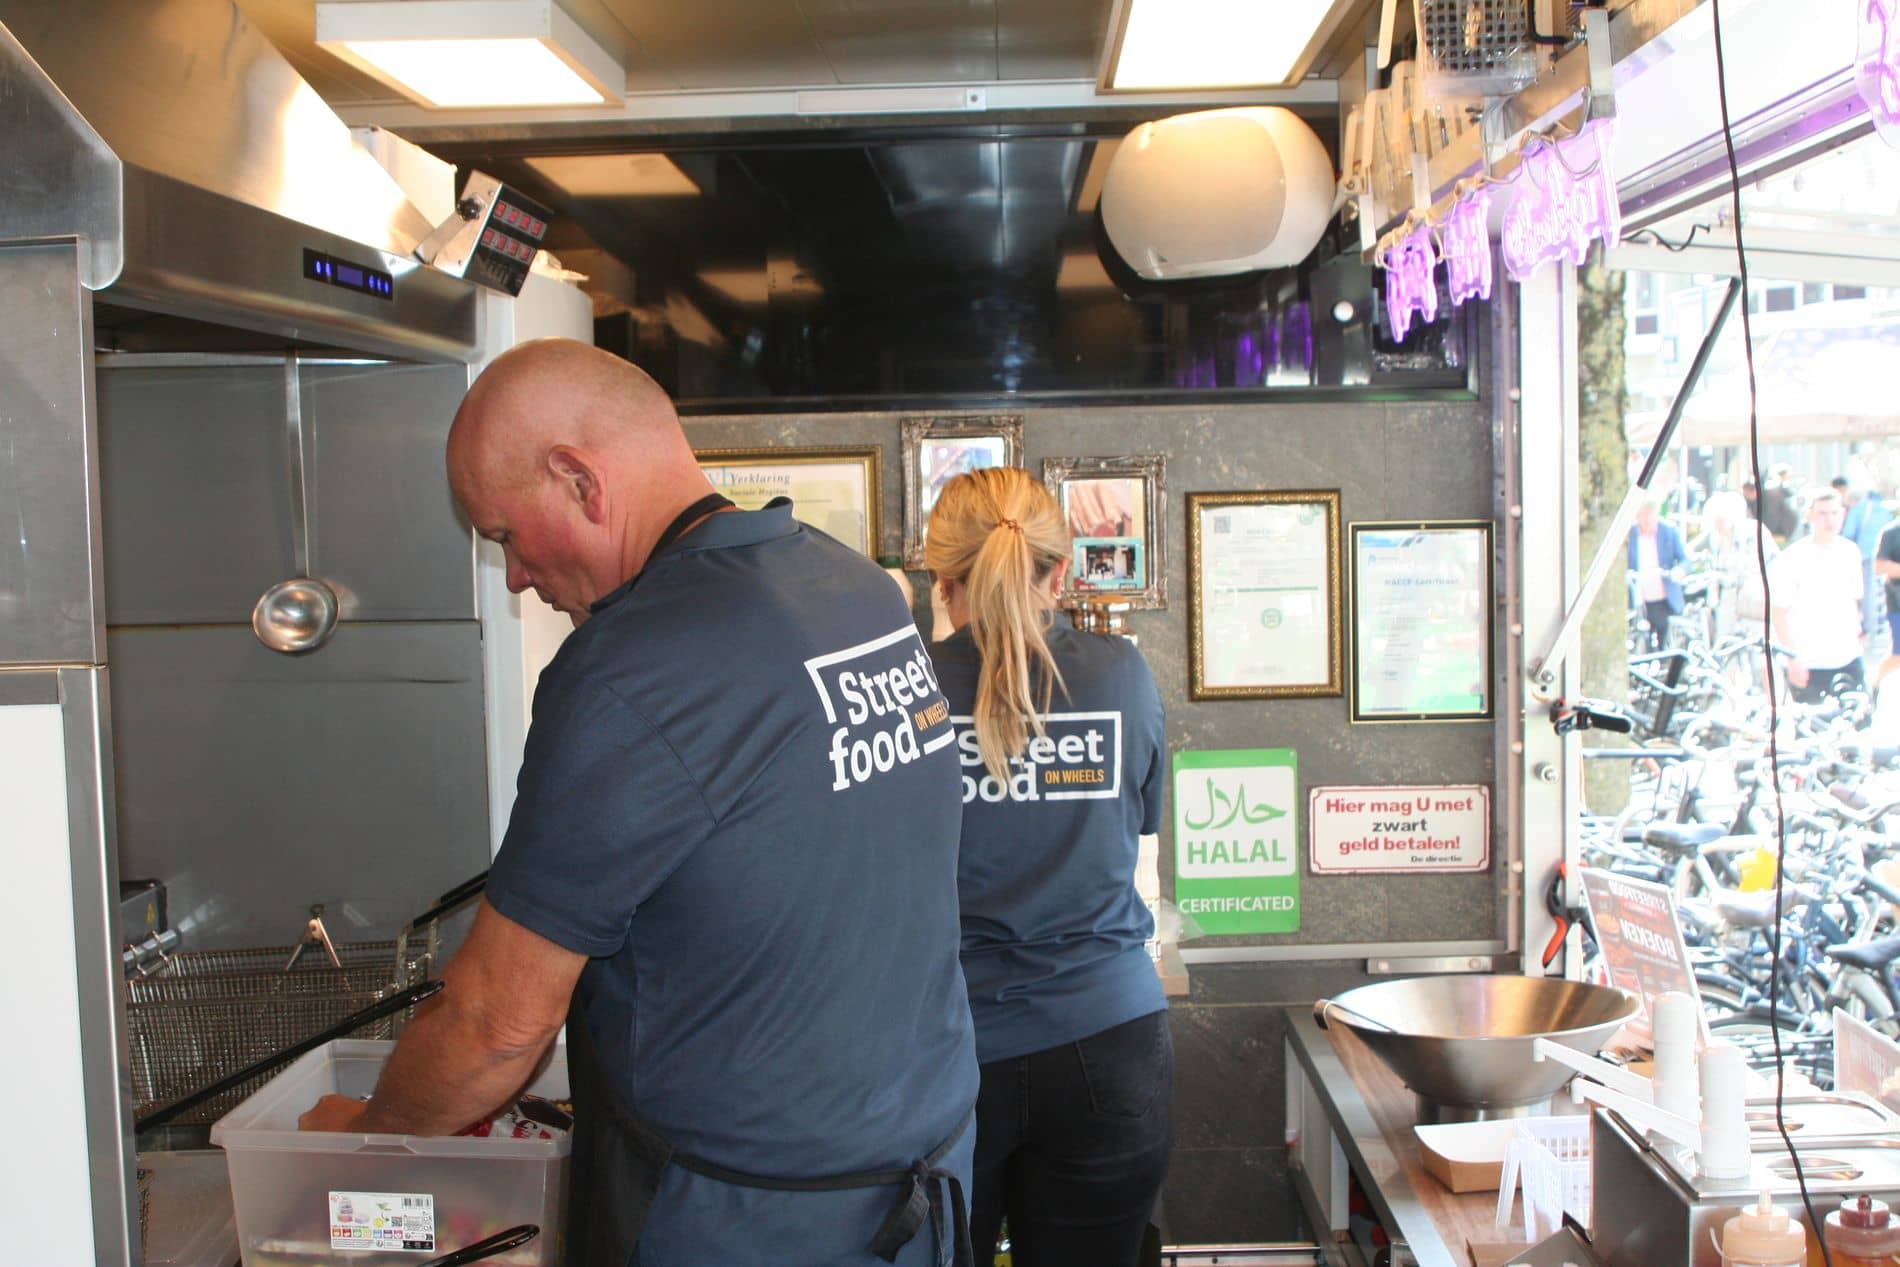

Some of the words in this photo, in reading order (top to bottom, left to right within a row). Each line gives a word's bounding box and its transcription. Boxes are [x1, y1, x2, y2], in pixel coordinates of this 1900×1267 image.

[839, 649, 937, 725] Street
[914, 711, 928, 731] ON
[829, 705, 920, 791] food
[1045, 770, 1060, 784] ON
[1062, 769, 1105, 783] WHEELS
[1185, 776, 1288, 830] حلال
[1326, 798, 1365, 813] Hier
[1370, 799, 1412, 816] mag
[1416, 797, 1431, 812] U
[1434, 797, 1473, 812] met
[1372, 818, 1427, 832] zwart
[1187, 839, 1288, 864] HALAL
[1339, 836, 1379, 855] geld
[1383, 835, 1461, 851] betalen!
[1411, 855, 1423, 863] De
[1425, 855, 1462, 863] directie
[1179, 895, 1295, 914] CERTIFICATED
